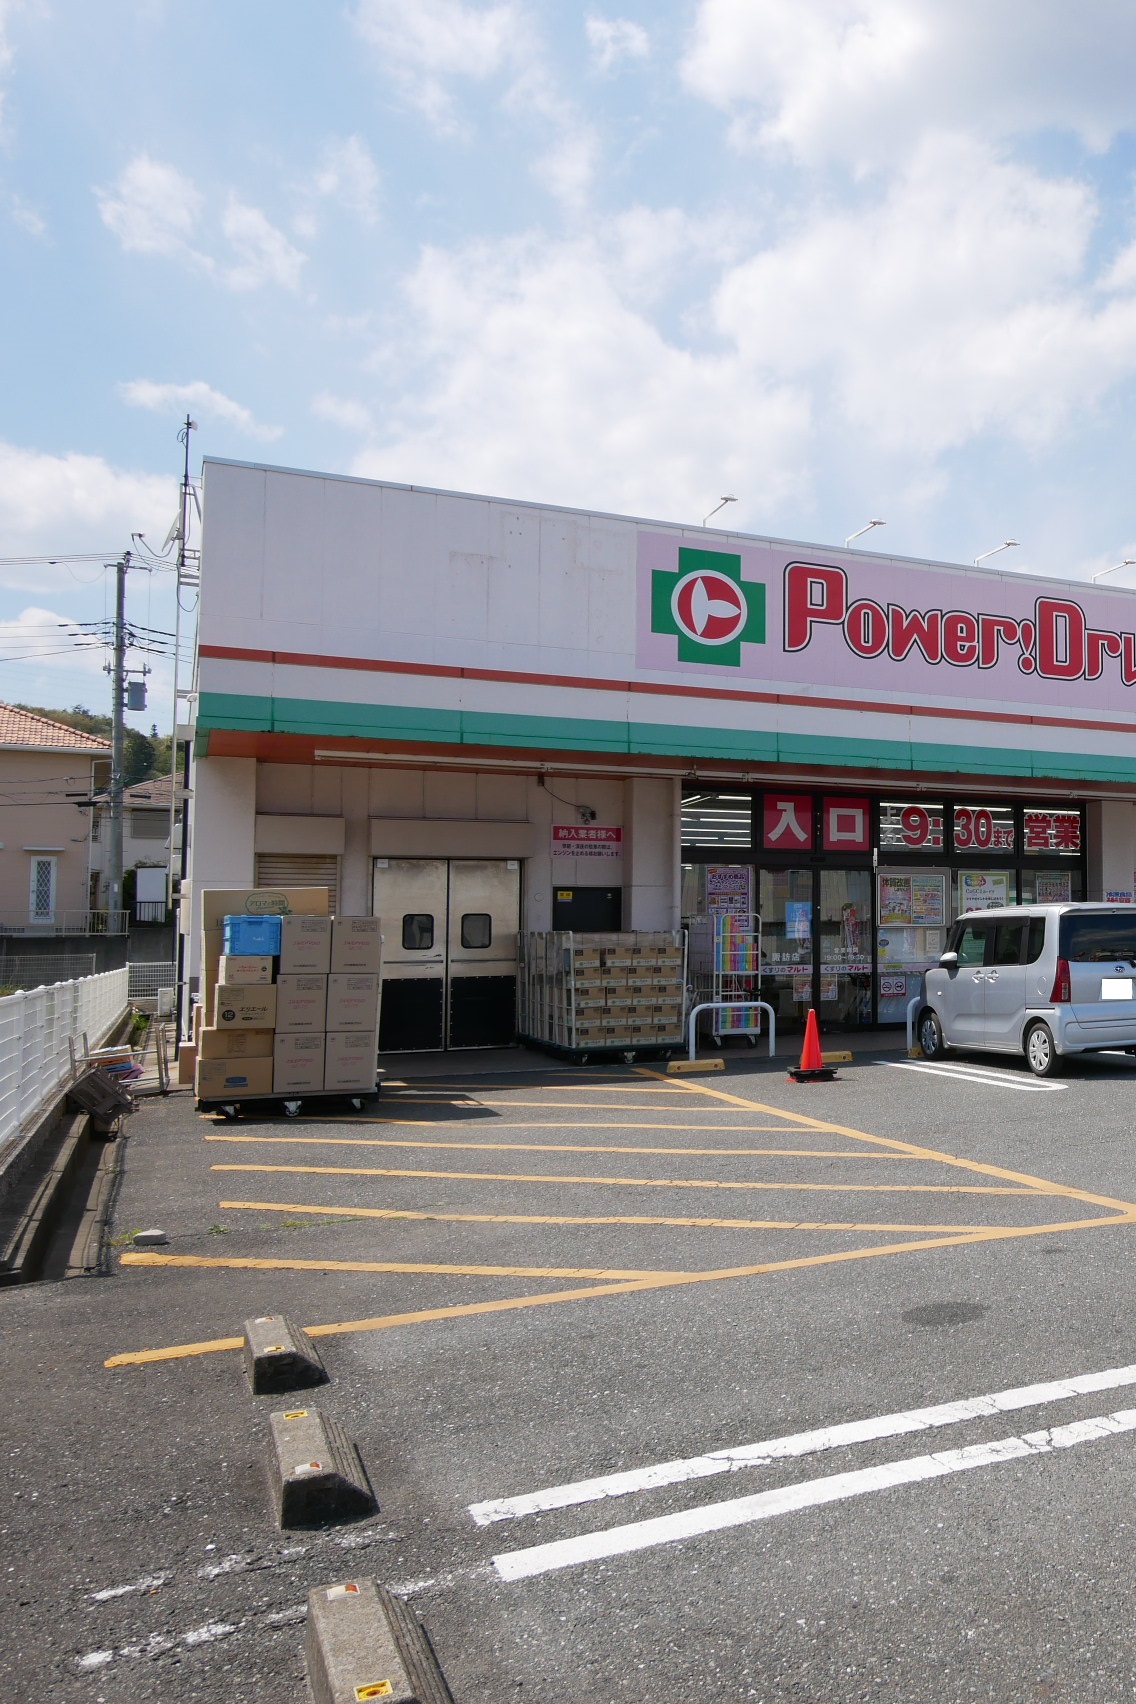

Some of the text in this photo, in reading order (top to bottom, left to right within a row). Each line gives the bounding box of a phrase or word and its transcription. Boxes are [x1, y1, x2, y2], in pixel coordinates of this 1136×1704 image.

[559, 829, 616, 839] 納入業者様へ
[768, 801, 864, 843] 入口
